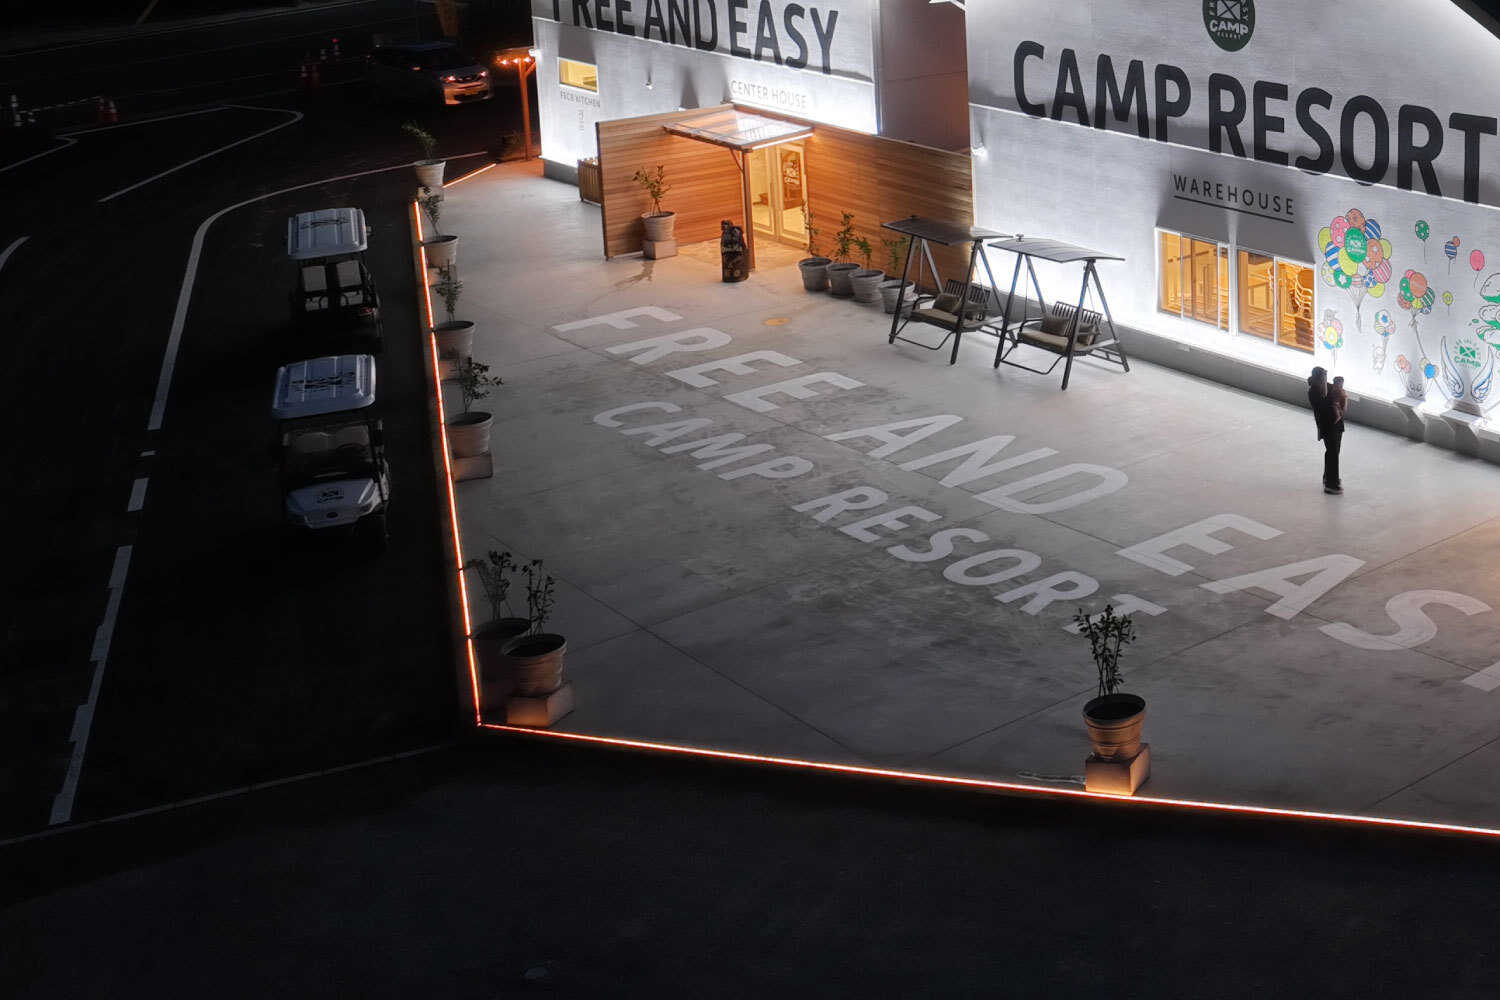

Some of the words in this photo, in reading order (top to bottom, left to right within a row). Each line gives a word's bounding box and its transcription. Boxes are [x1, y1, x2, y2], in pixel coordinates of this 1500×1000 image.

[1210, 19, 1249, 35] CAMP
[731, 79, 768, 99] CENTER
[772, 87, 807, 109] HOUSE
[1013, 40, 1191, 143] CAMP
[1208, 73, 1498, 204] RESORT
[1173, 174, 1294, 216] WAREHOUSE
[552, 305, 867, 413] FREE
[822, 414, 1129, 514] AND
[593, 401, 815, 481] CAMP
[791, 486, 1168, 635] RESORT
